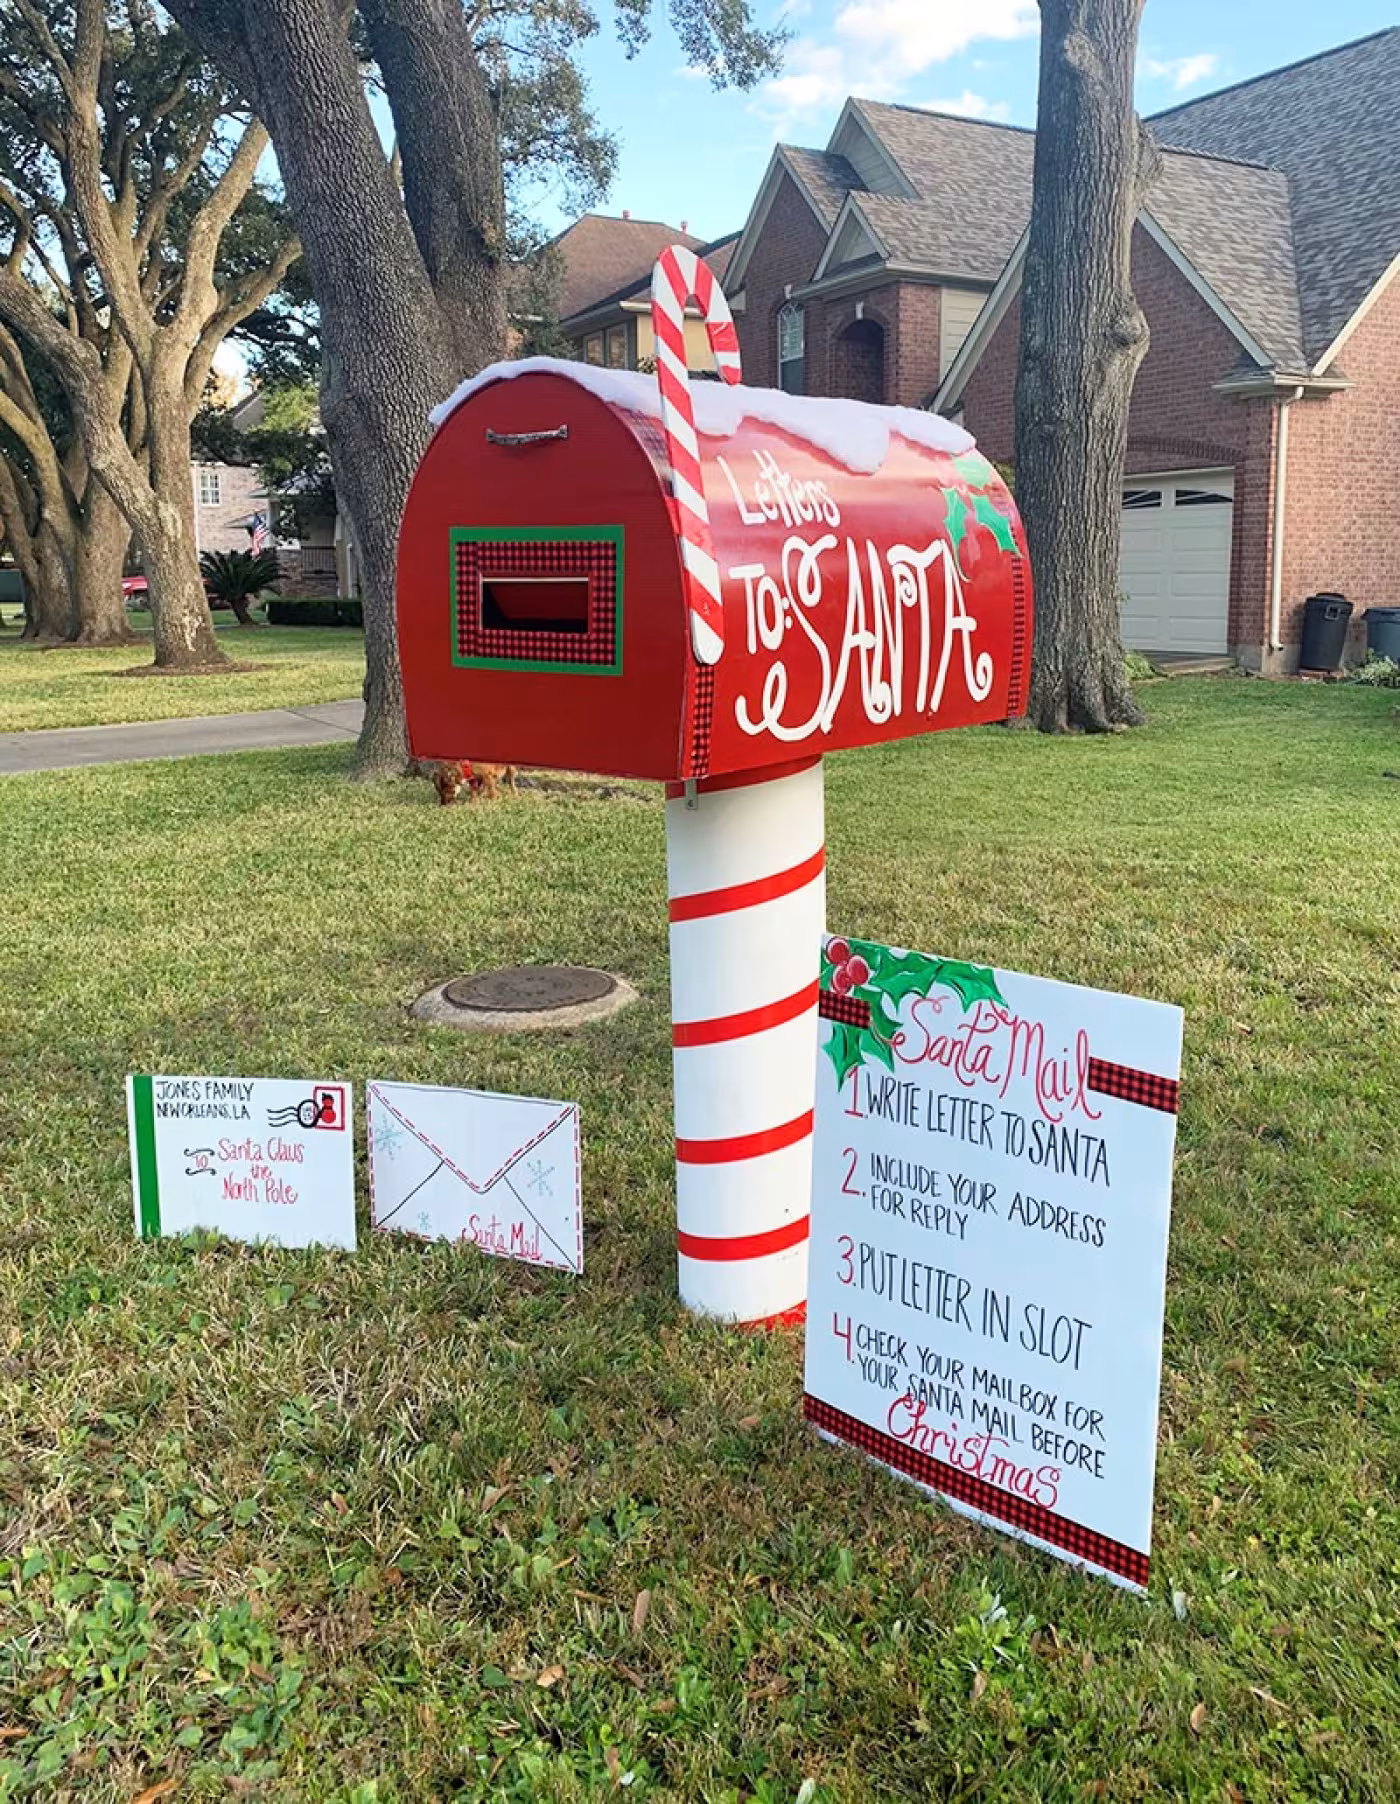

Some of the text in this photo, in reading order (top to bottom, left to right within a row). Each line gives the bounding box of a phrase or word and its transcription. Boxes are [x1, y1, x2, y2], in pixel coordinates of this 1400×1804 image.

[717, 449, 840, 528] Letters
[728, 534, 993, 742] TO: SANTA
[156, 1081, 254, 1101] JONES FAMILY
[892, 995, 1102, 1123] Santa Mail
[157, 1102, 180, 1118] NEW
[233, 1104, 250, 1120] LA
[217, 1137, 305, 1163] Santa Claus
[866, 1071, 921, 1128] WRITE
[927, 1090, 995, 1150] LETTER
[1000, 1110, 1025, 1157] TO
[1029, 1120, 1111, 1188] SANTA
[221, 1172, 298, 1204] North Pole
[251, 1162, 272, 1180] the
[841, 1148, 1107, 1249] 2. INCLUDE YOUR ADDRESS
[871, 1185, 969, 1241] FOR REPLY
[461, 1213, 543, 1260] Santa Mail
[836, 1235, 1093, 1371] 3. PUT LETTER IN SLOT
[855, 1322, 909, 1368] CHECK
[916, 1344, 965, 1390] YOUR
[972, 1365, 1058, 1422] MAILBOX
[1064, 1400, 1107, 1442] FOR
[857, 1352, 1106, 1480] YOUR SANTA MAIL BEFORE
[886, 1391, 1062, 1510] Christmas
